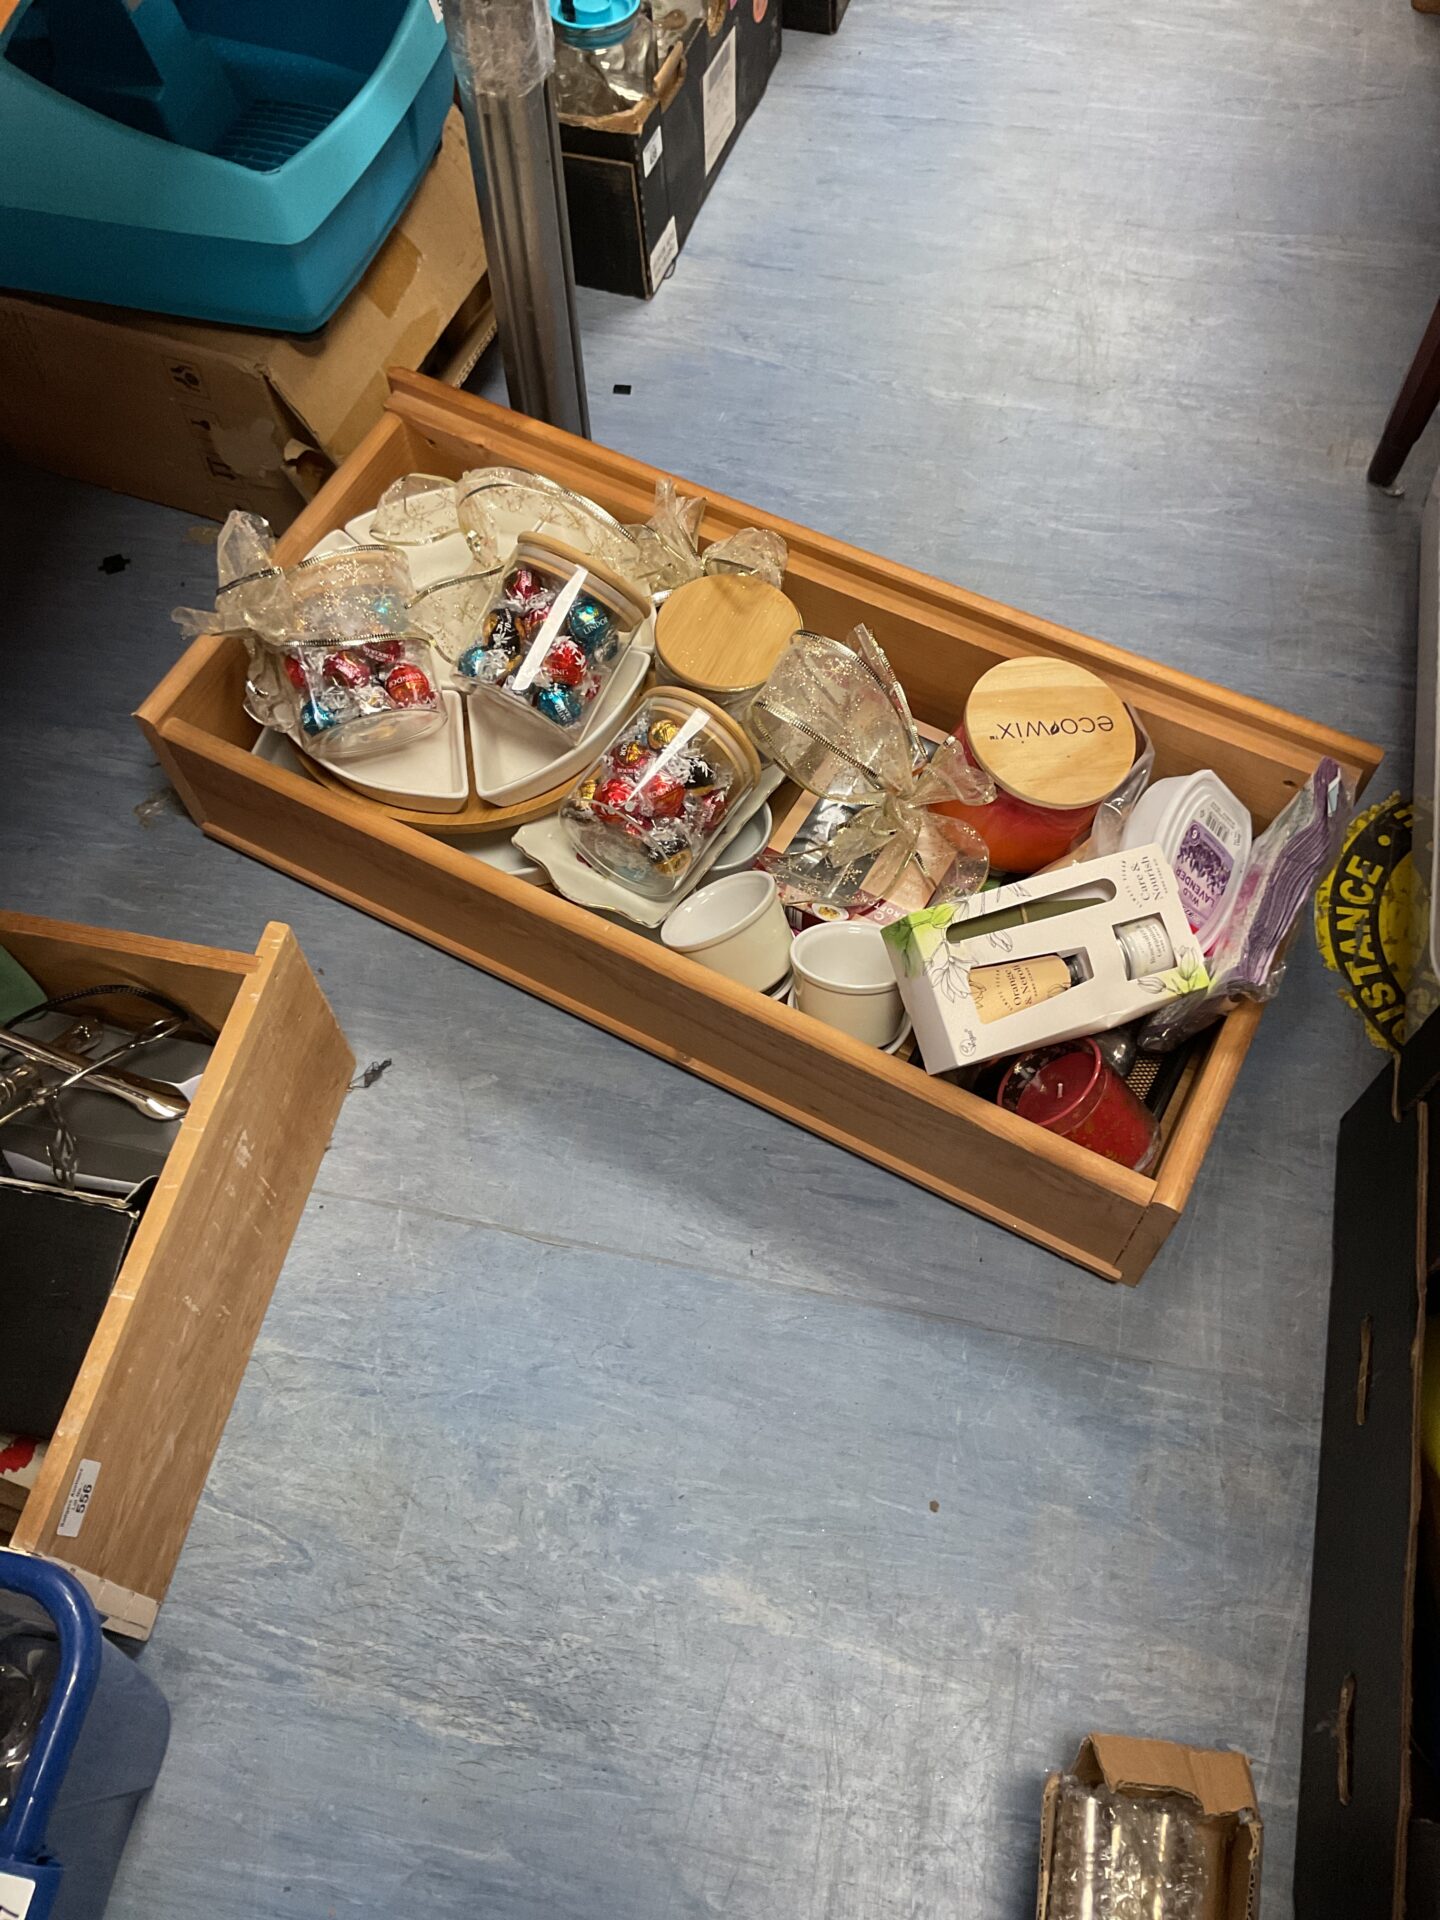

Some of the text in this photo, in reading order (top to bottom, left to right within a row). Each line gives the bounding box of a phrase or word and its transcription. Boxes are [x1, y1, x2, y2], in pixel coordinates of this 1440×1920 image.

[1137, 874, 1151, 901] Care
[1141, 856, 1164, 901] Nourish
[1176, 868, 1216, 908] LAVENDER
[1005, 969, 1022, 1006] Orange
[1014, 964, 1031, 995] Neroli
[76, 1484, 92, 1514] 556
